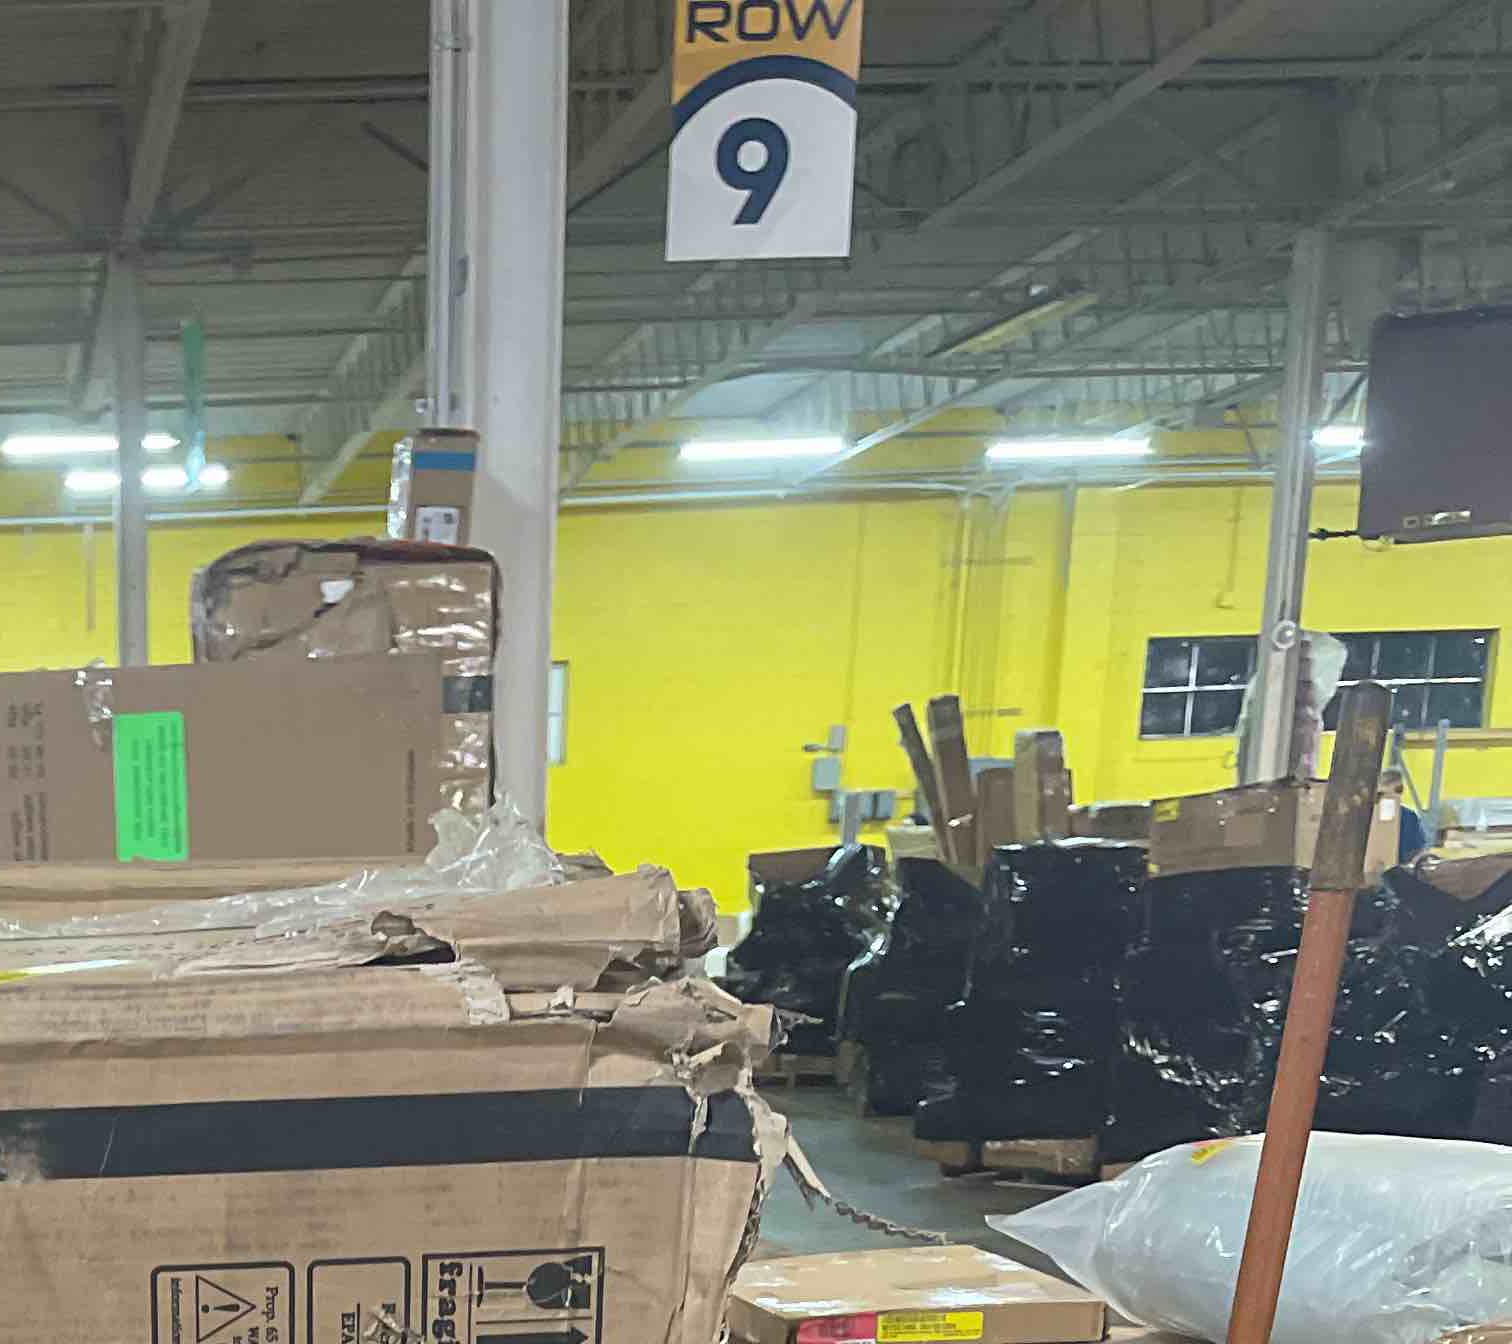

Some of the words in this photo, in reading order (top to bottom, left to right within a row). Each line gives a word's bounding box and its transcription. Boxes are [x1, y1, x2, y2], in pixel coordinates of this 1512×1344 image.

[685, 0, 854, 43] ROW
[716, 117, 788, 226] 9
[262, 1286, 279, 1323] Prop.
[266, 1326, 278, 1343] 65
[341, 1312, 354, 1344] EPA
